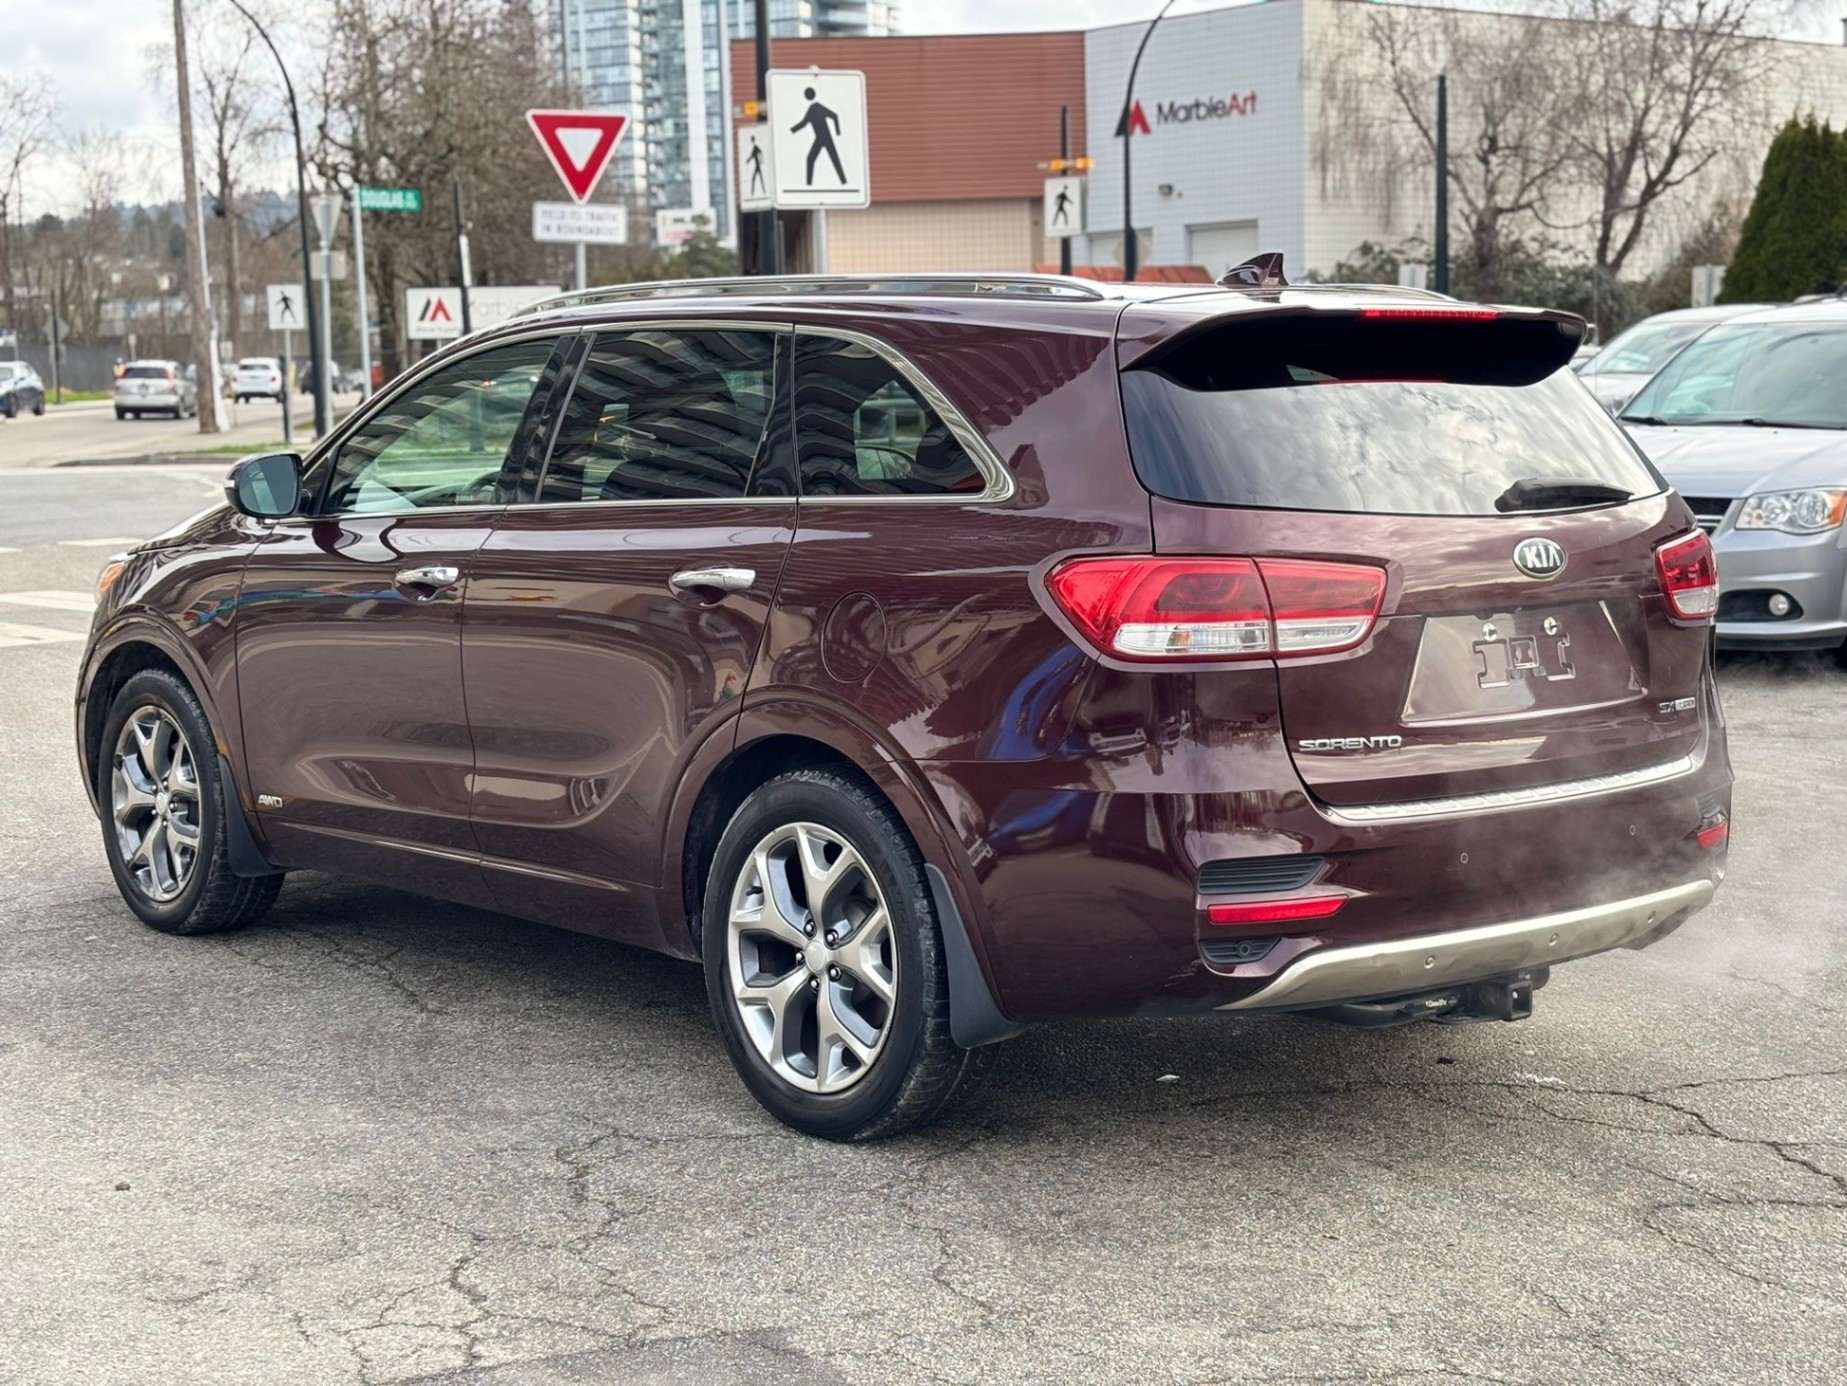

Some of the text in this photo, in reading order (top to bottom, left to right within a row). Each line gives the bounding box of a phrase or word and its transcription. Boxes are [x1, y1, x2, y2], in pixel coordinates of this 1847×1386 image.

[1157, 91, 1257, 125] MarbleArt
[1522, 545, 1561, 568] KIA
[1298, 734, 1403, 752] SORENTO
[258, 794, 283, 808] AWD
